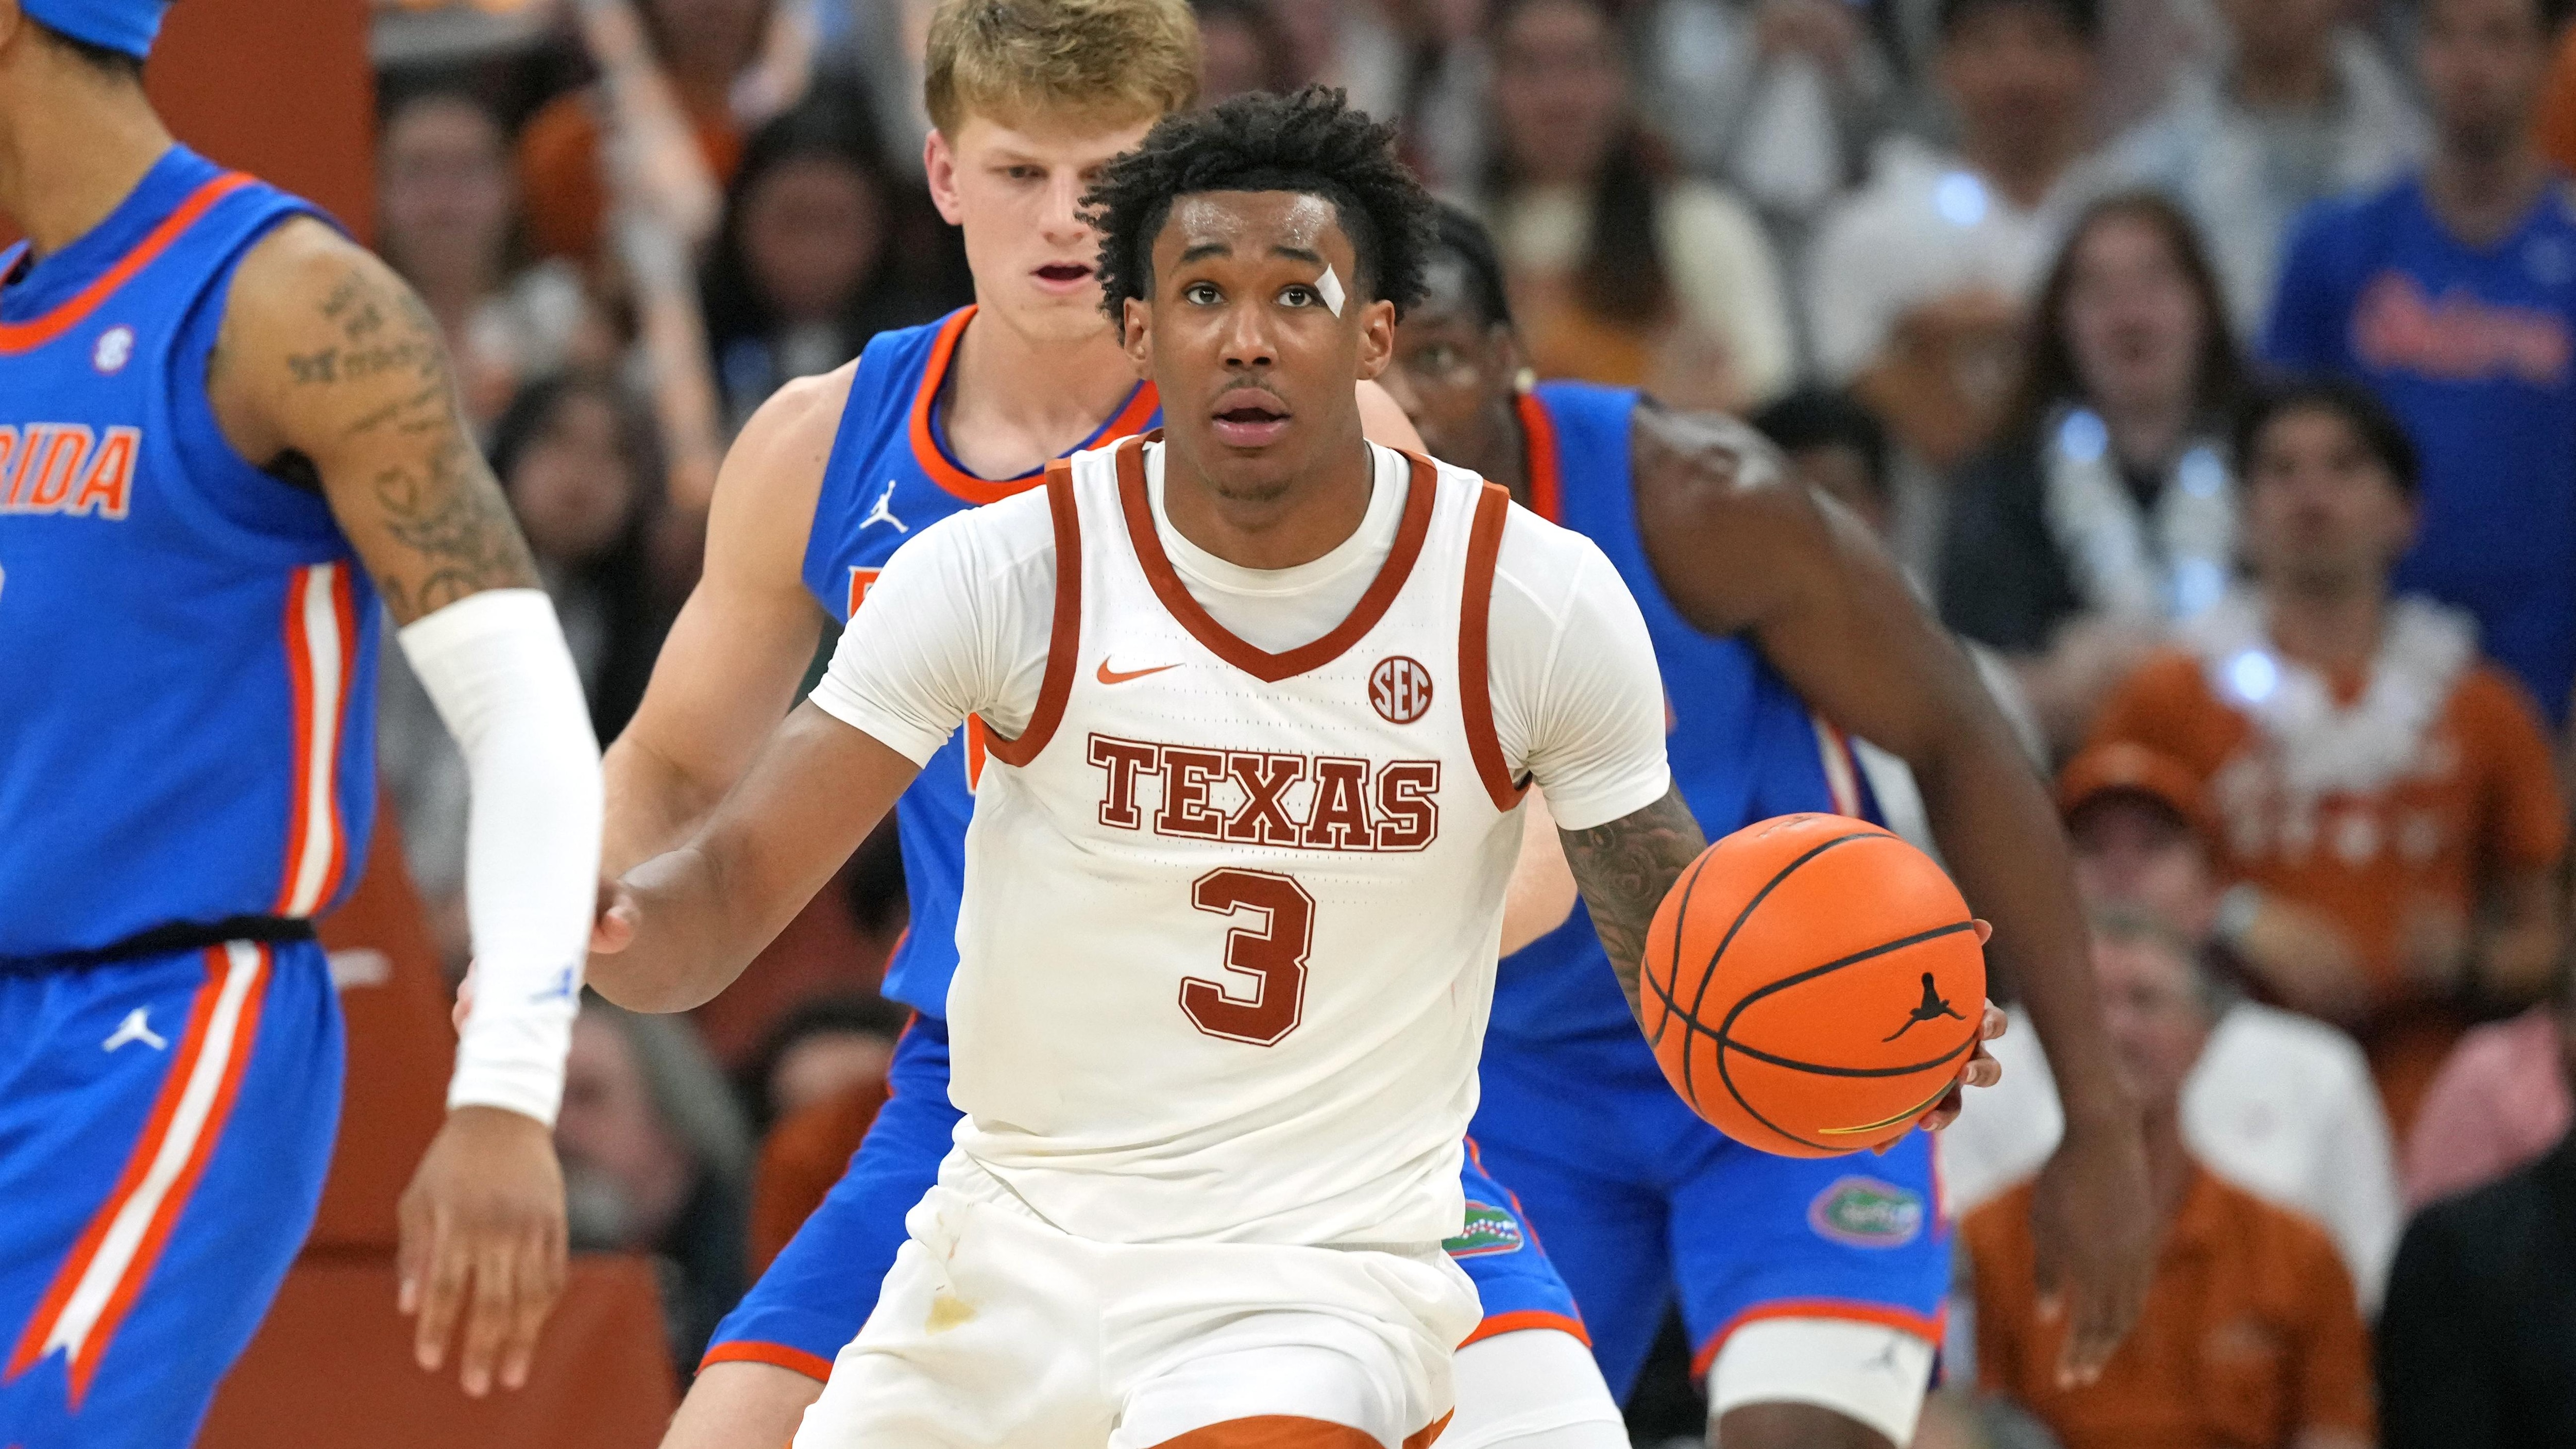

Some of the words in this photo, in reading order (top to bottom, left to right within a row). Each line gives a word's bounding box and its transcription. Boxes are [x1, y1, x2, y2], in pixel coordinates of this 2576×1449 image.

[1371, 658, 1430, 721] SEC
[1087, 733, 1440, 852] TEXAS
[1179, 867, 1315, 1047] 3
